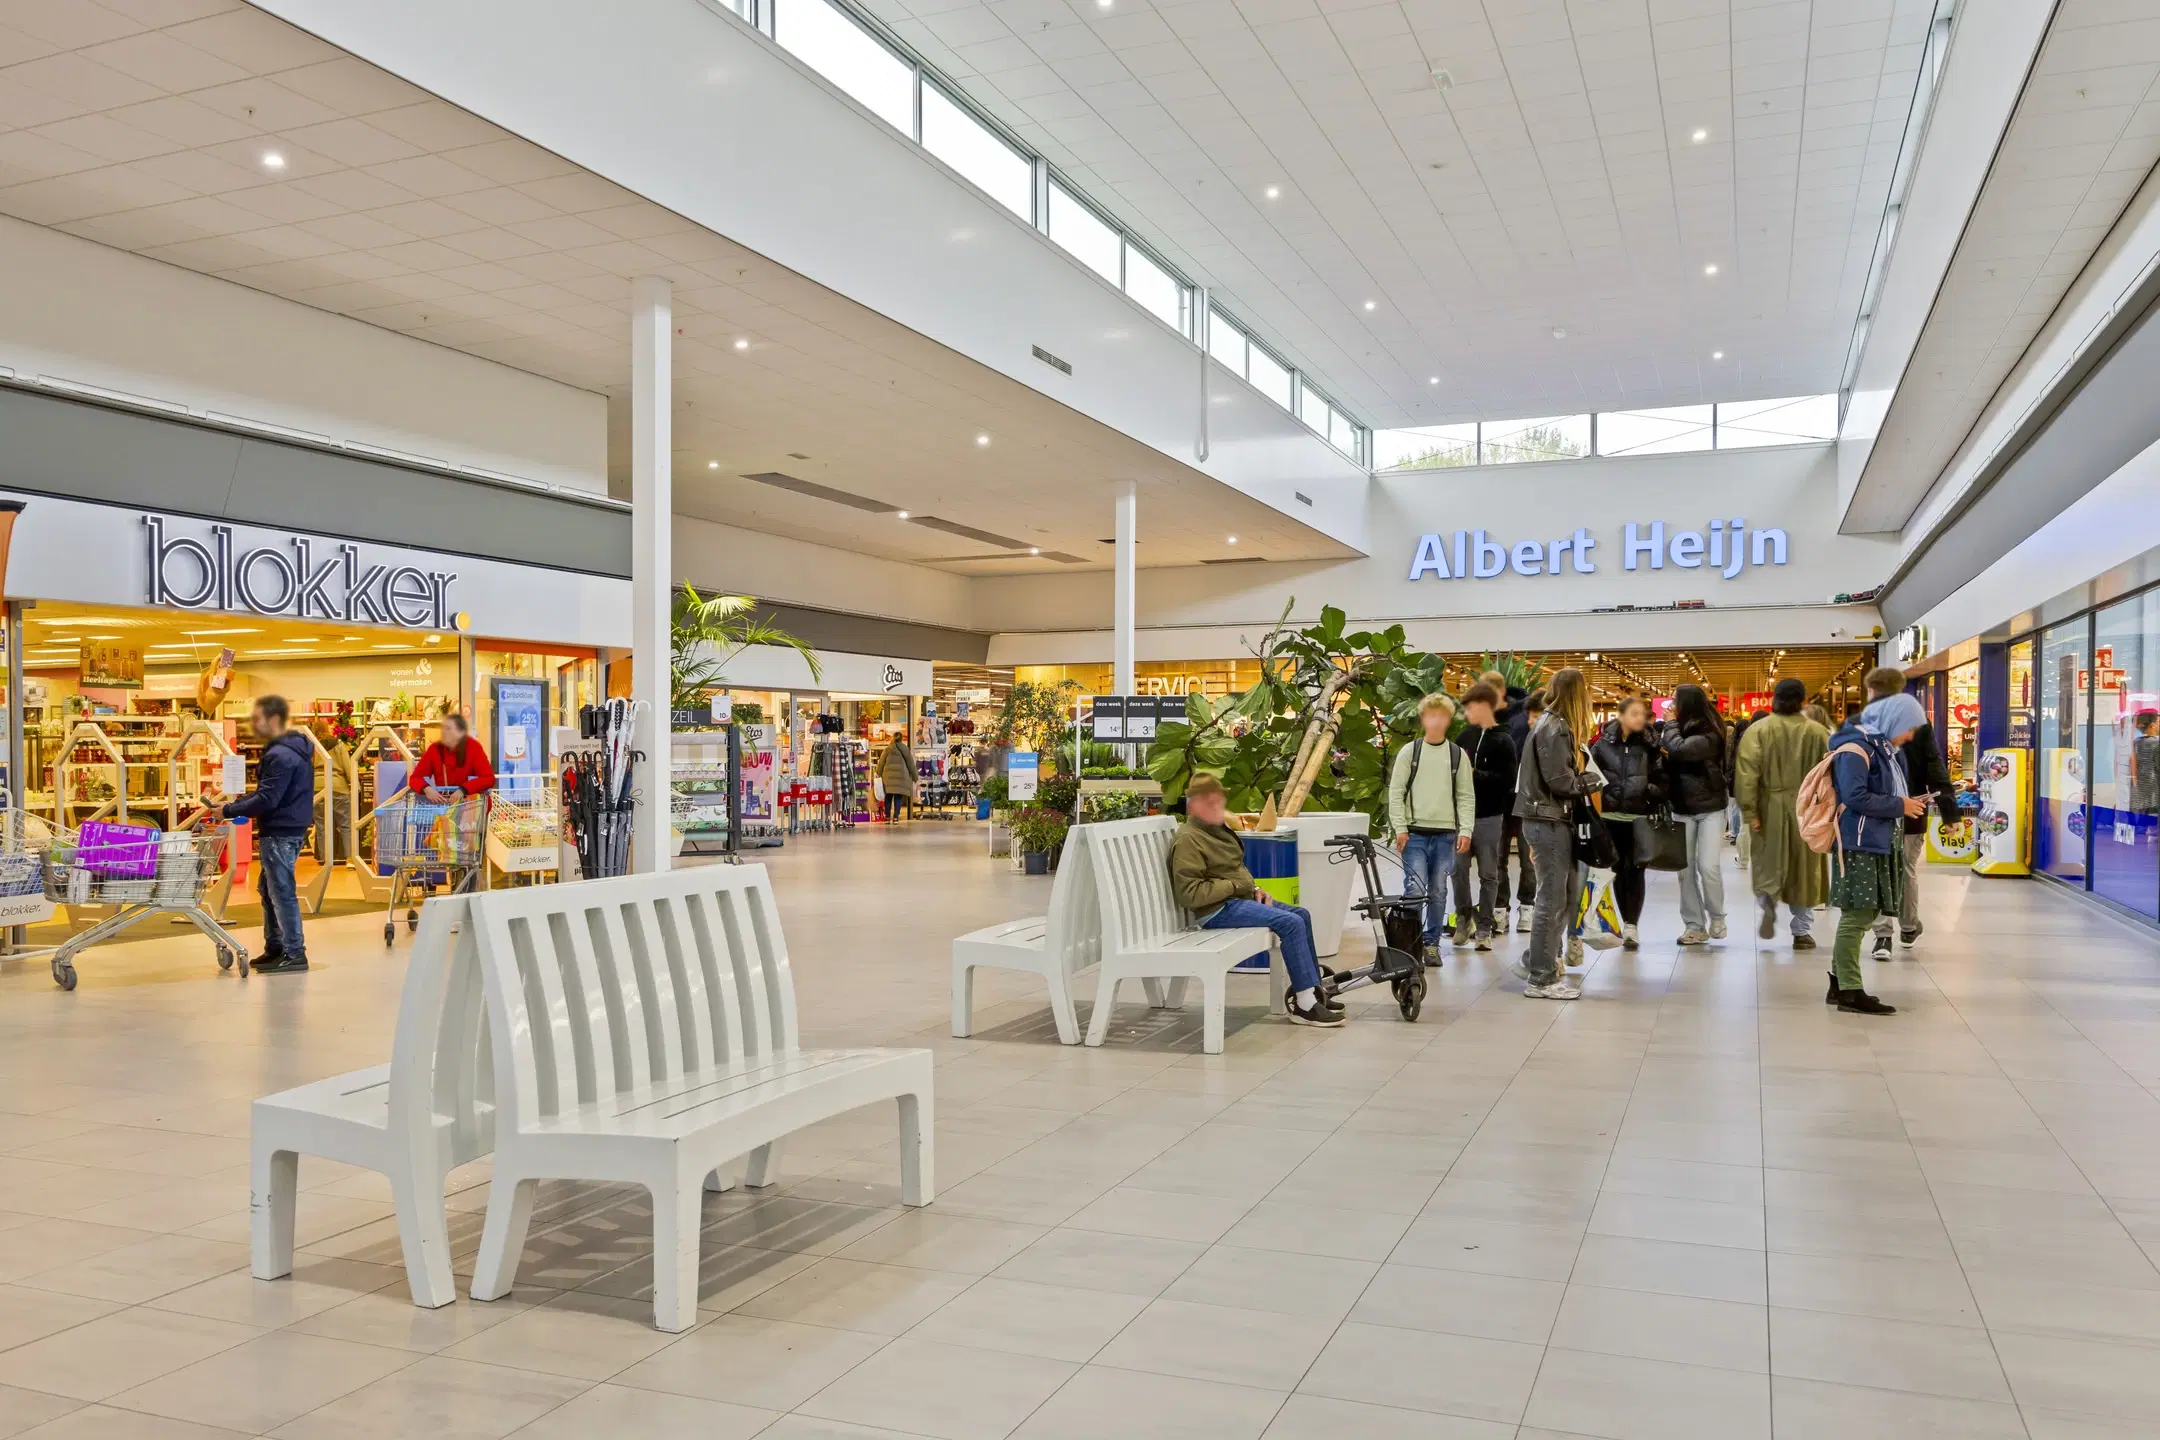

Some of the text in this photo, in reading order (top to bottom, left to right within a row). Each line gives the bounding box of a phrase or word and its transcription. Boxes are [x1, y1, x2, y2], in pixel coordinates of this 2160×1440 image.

[1408, 516, 1788, 580] Albert Heijn
[142, 514, 471, 632] blokker.
[522, 713, 537, 724] 25%
[744, 725, 763, 744] Etos
[1940, 837, 1966, 848] Play
